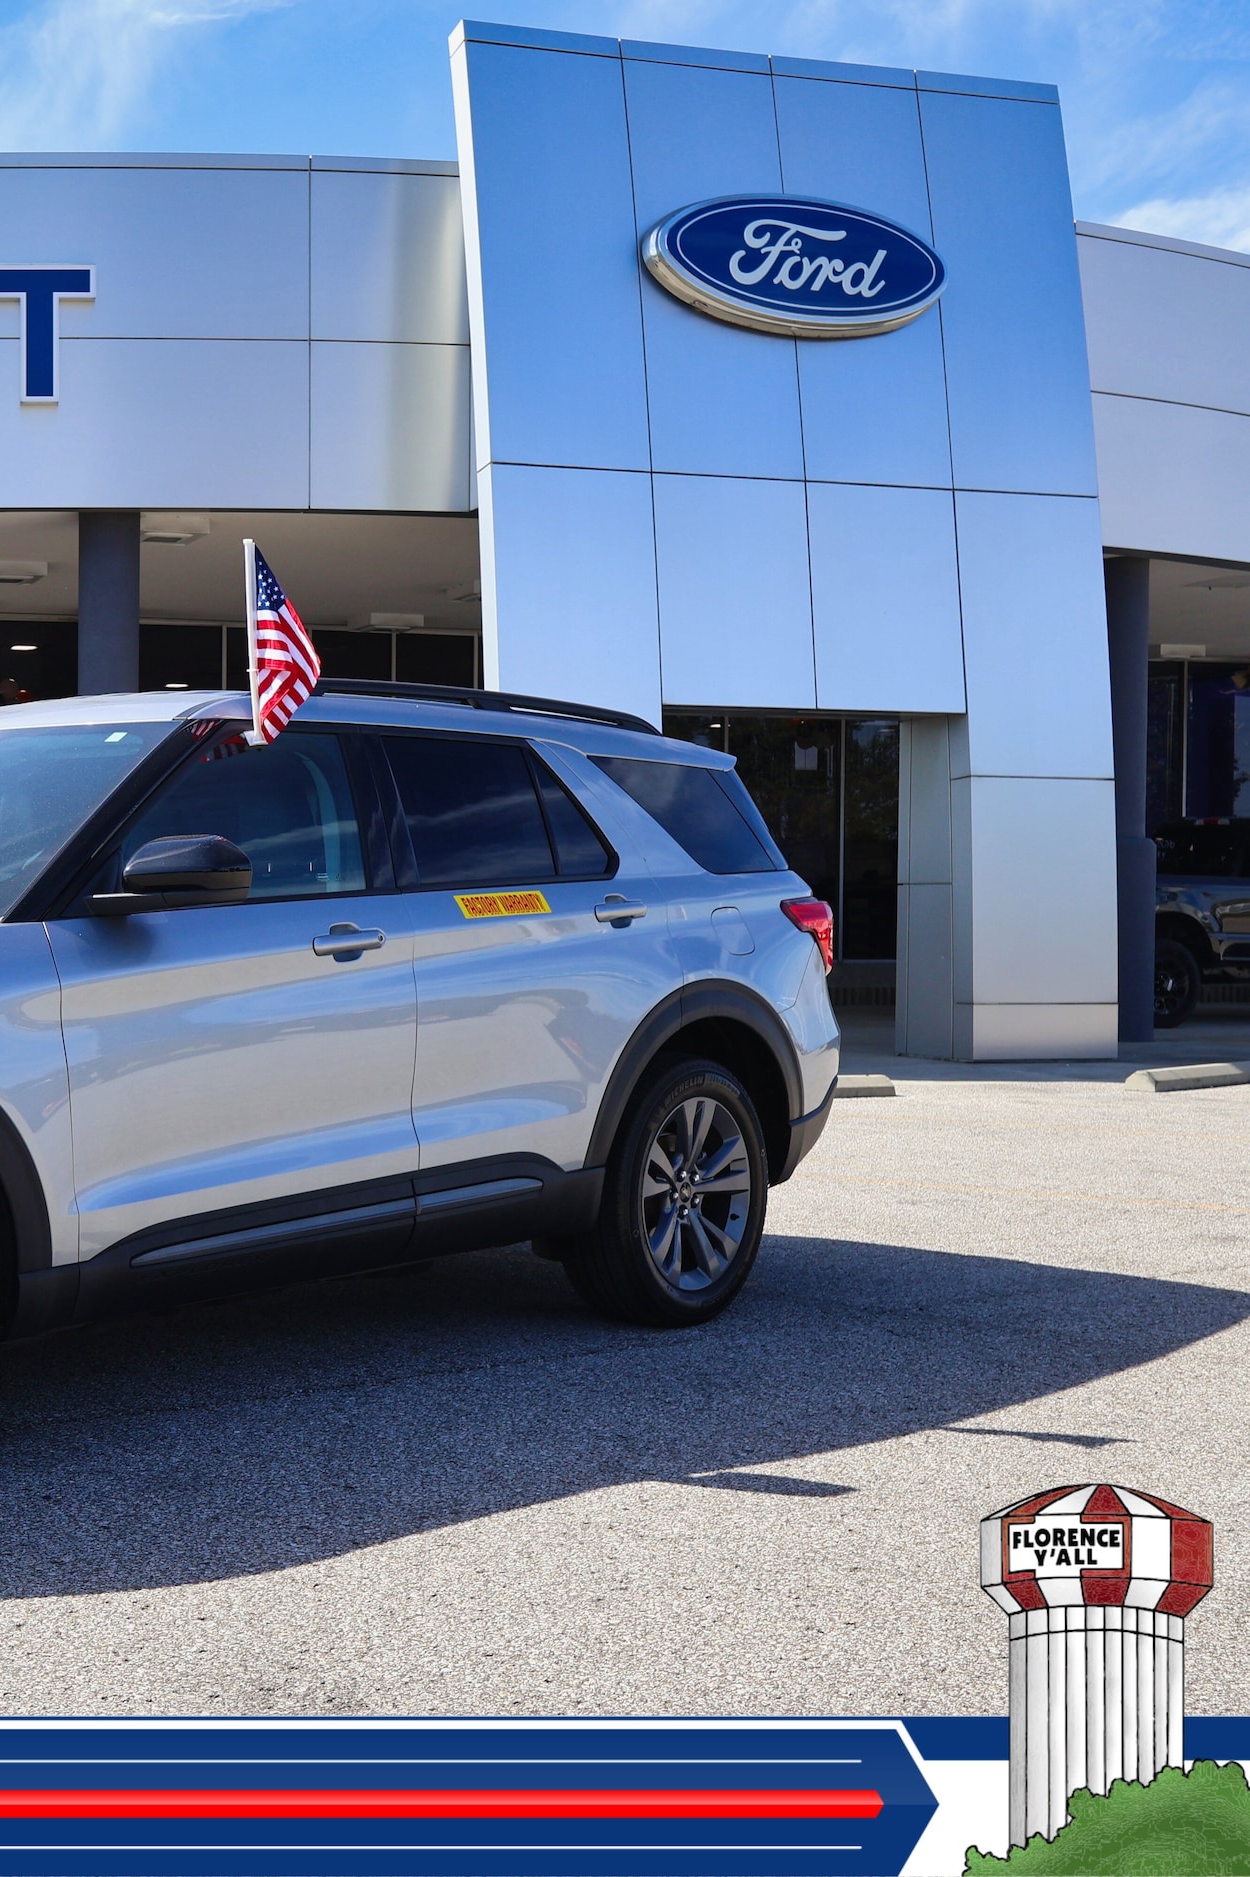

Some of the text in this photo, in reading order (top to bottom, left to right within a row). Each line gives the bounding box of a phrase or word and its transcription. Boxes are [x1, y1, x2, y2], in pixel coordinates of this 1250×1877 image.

[729, 218, 888, 298] Ford
[461, 893, 547, 917] FACTORY WARRANTY
[664, 1075, 705, 1108] MICHELIN
